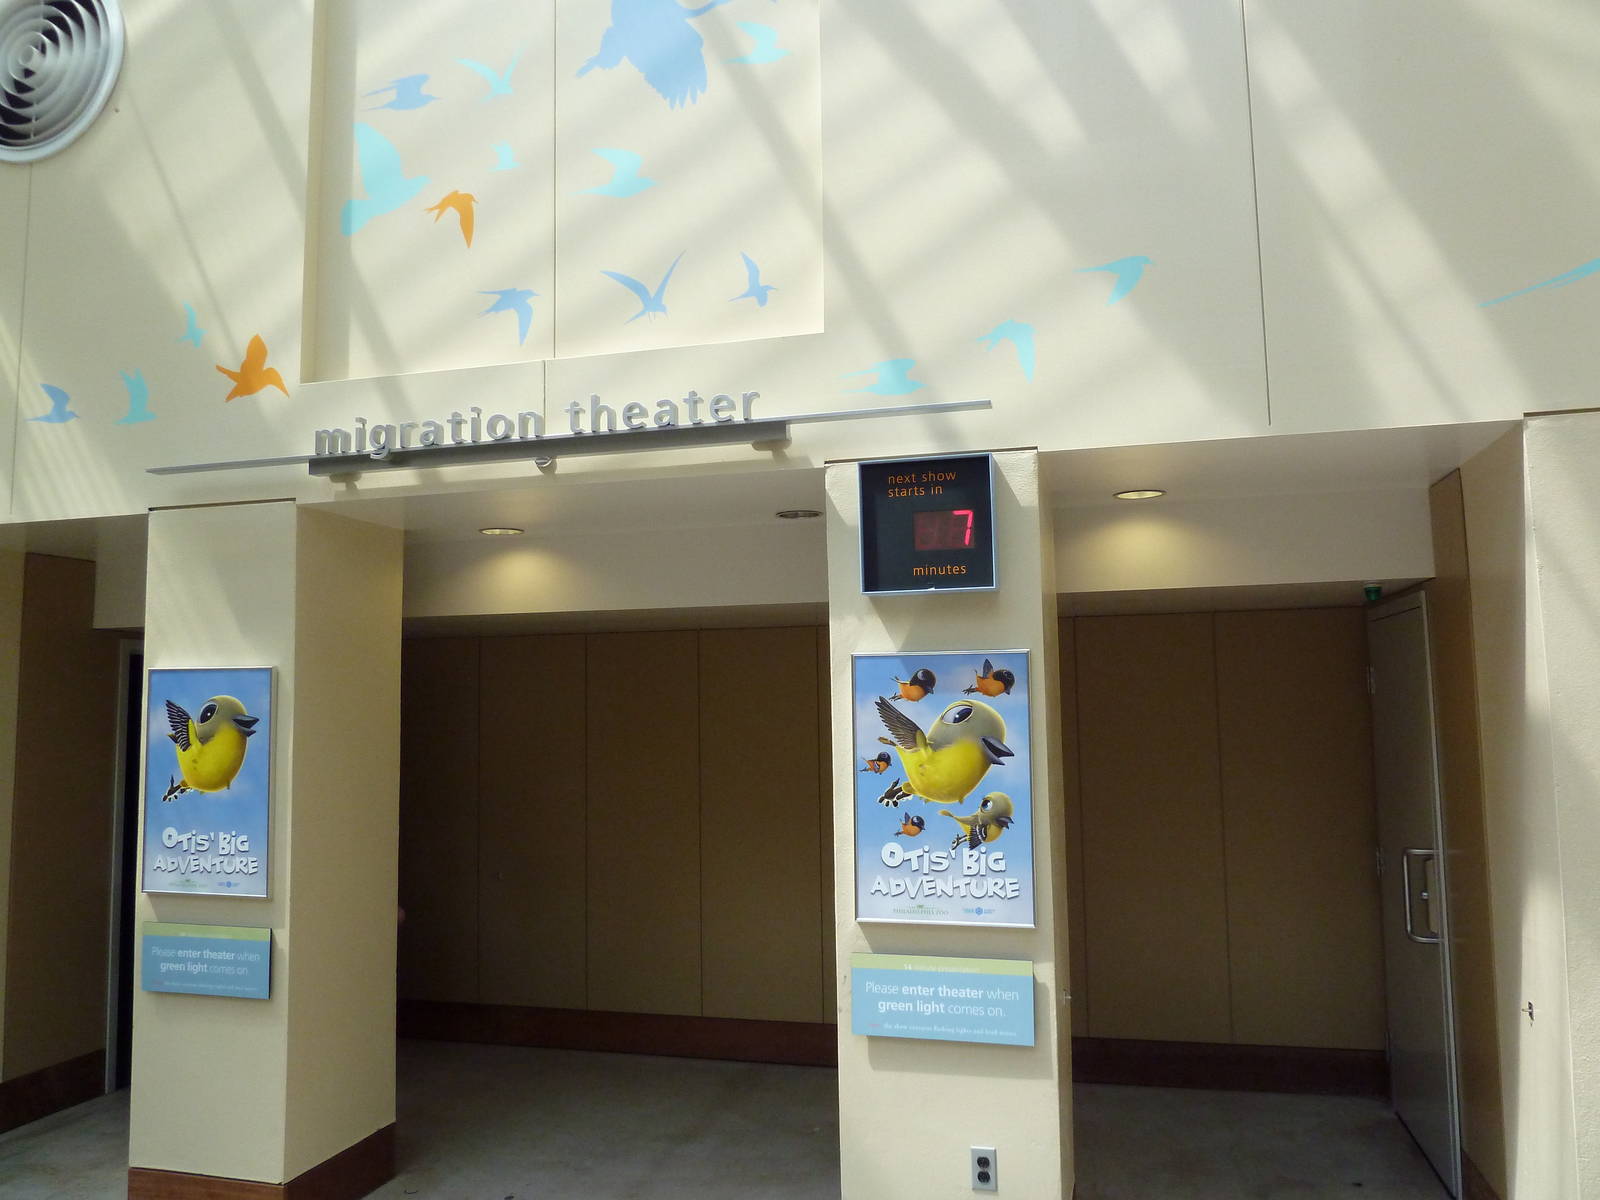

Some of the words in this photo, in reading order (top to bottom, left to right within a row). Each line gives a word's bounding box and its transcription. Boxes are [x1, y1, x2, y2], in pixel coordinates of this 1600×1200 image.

[314, 406, 543, 460] migration
[563, 391, 761, 435] theater
[888, 473, 917, 485] next
[922, 471, 957, 482] show
[888, 486, 926, 498] starts
[931, 484, 943, 495] in
[952, 509, 974, 546] 7
[913, 564, 968, 577] minutes
[153, 854, 259, 875] ADVENTURE
[870, 875, 1020, 899] ADVENTURE
[177, 949, 202, 959] enter
[203, 949, 236, 960] theater
[237, 952, 260, 962] when
[160, 961, 185, 973] green
[187, 962, 208, 974] light
[865, 981, 899, 994] Please
[901, 984, 936, 997] enter
[938, 985, 985, 999] theater
[986, 988, 1020, 1001] when
[878, 1000, 913, 1013] green
[917, 1000, 945, 1016] light
[947, 1005, 985, 1017] comes
[988, 1006, 1007, 1017] on.
